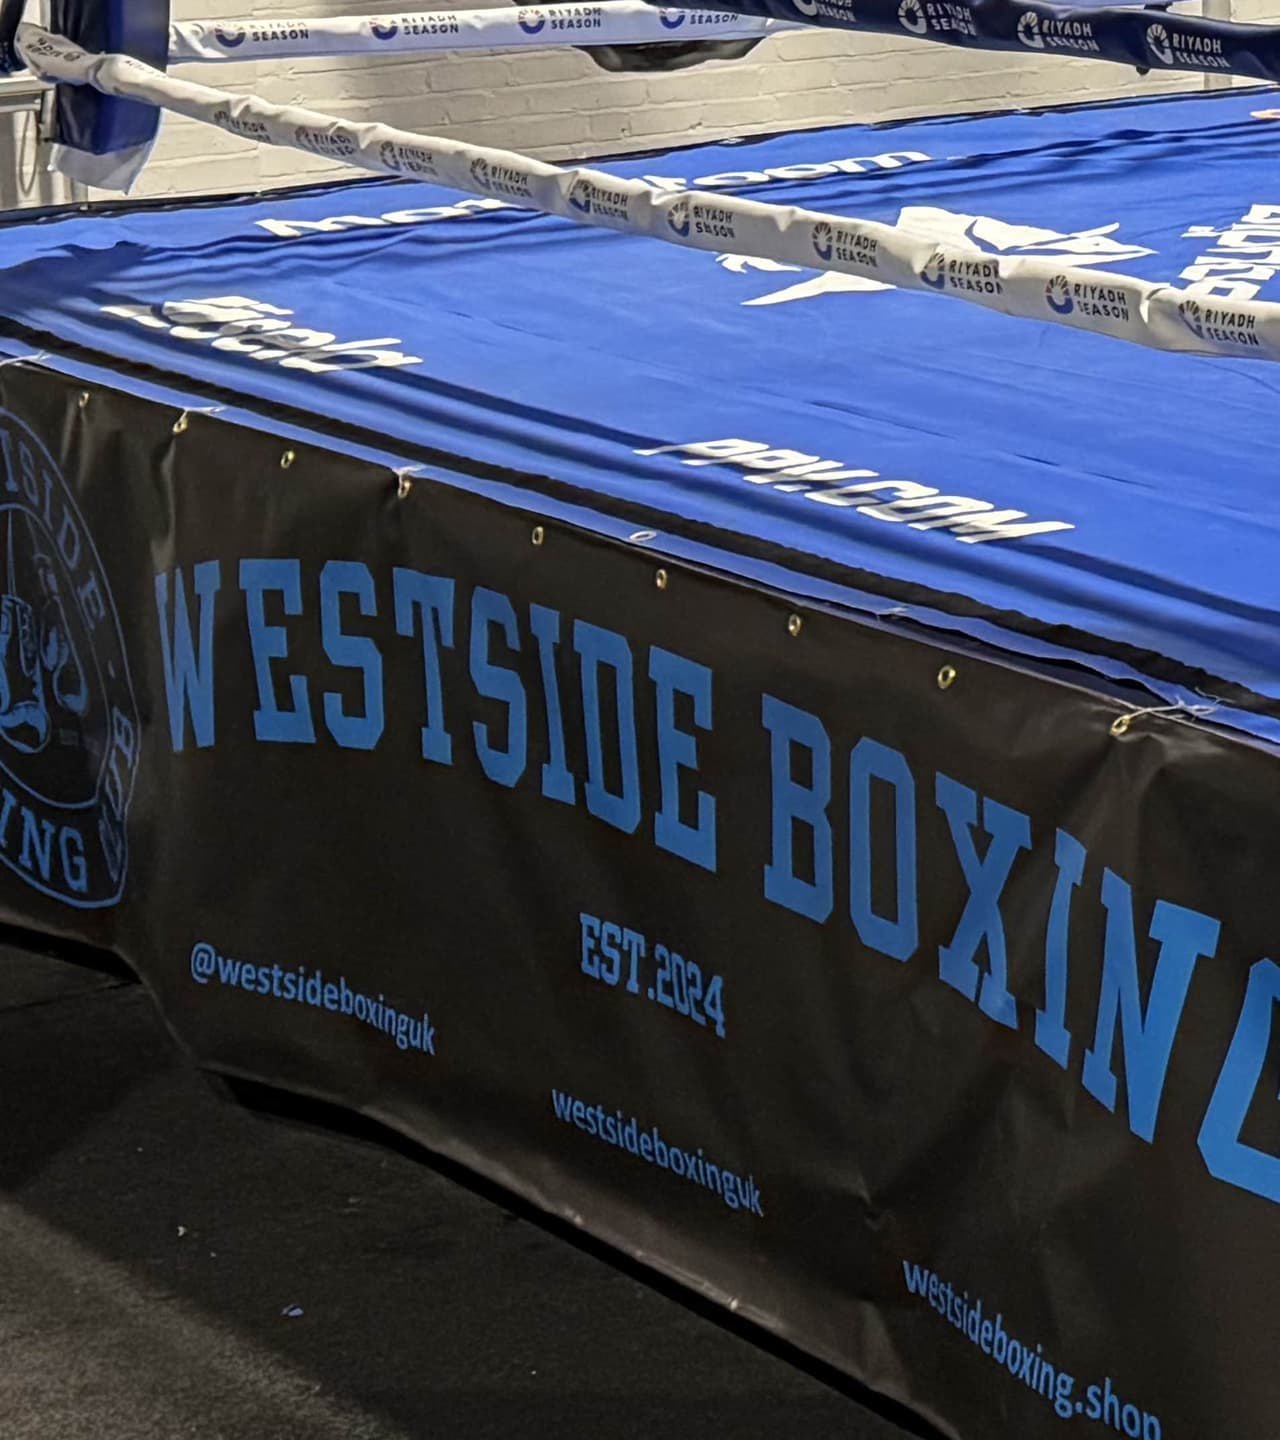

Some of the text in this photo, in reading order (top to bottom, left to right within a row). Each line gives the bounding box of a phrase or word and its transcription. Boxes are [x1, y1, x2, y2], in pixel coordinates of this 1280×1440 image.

[252, 28, 309, 41] SEASON
[1174, 32, 1222, 55] RIYADH
[1075, 284, 1126, 306] RIYADH
[1205, 309, 1255, 329] RIYADH
[1204, 326, 1259, 346] SEASON
[154, 559, 718, 872] WESTSIDE
[579, 912, 726, 1038] EST.2024
[191, 942, 437, 1056] @westsideboxinguk
[551, 1088, 765, 1219] westsideboxinguk
